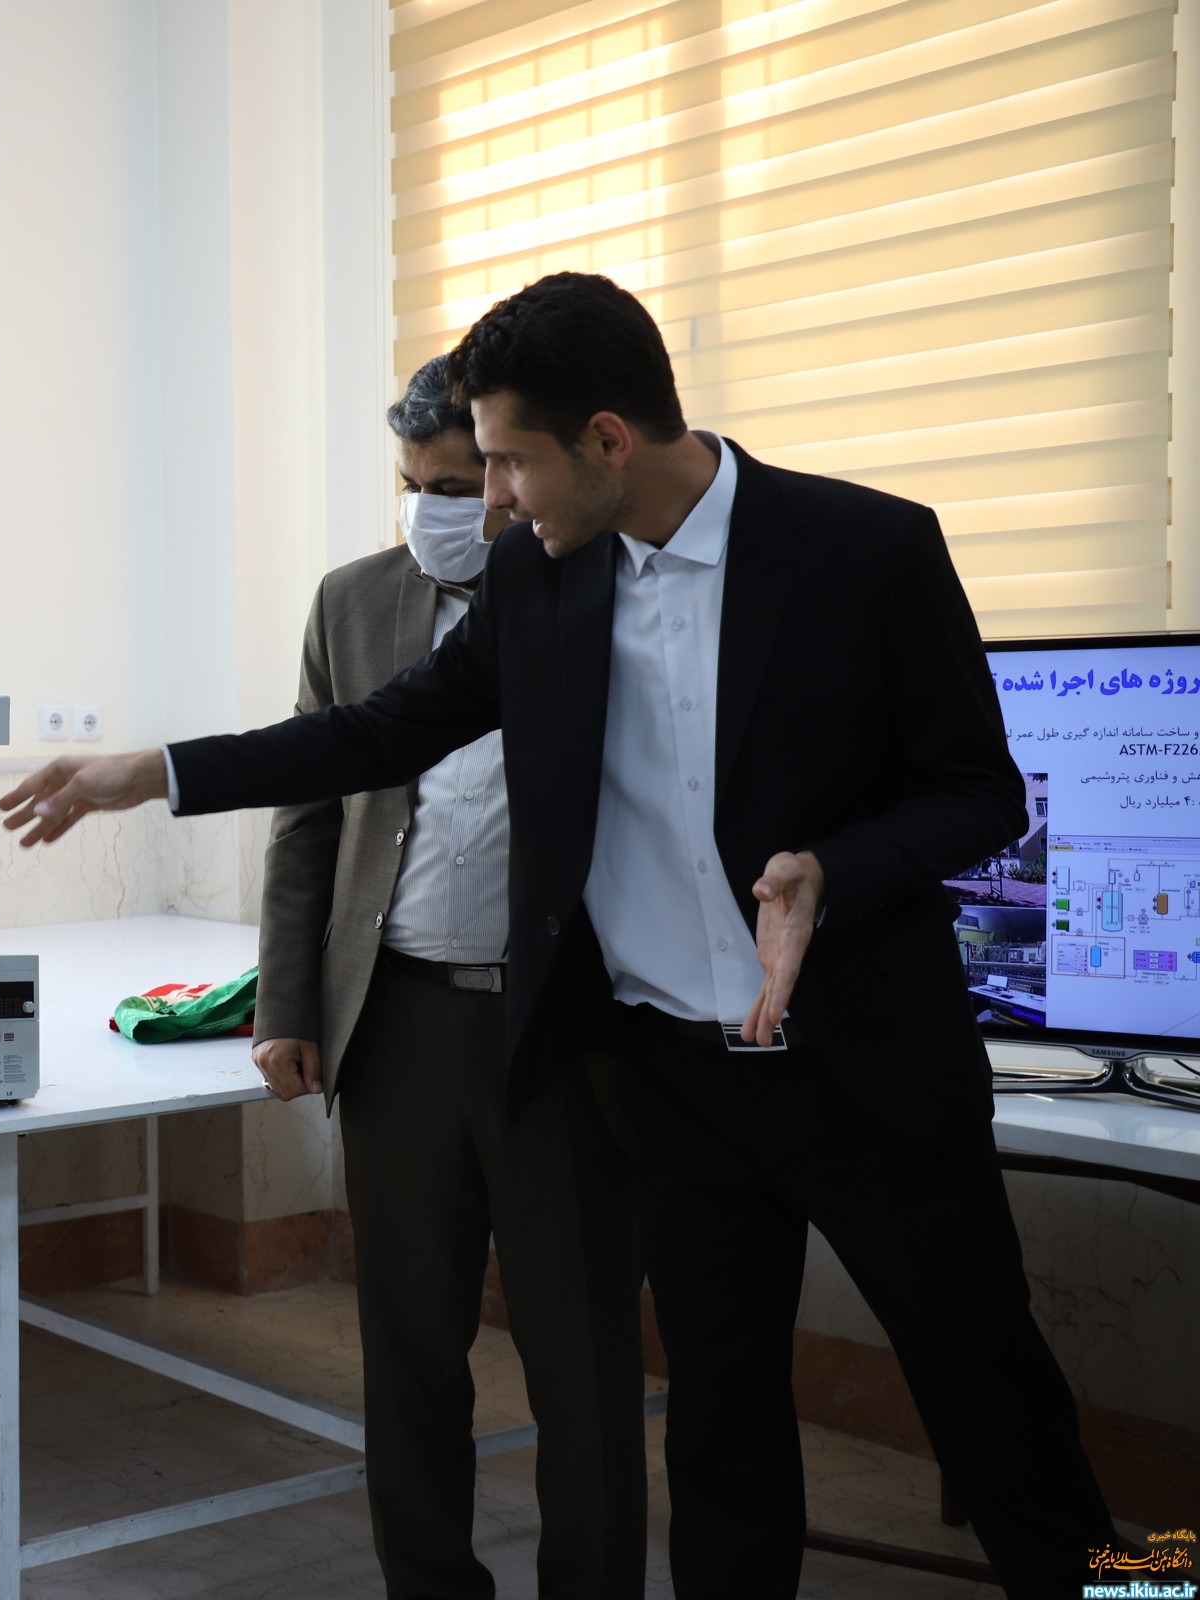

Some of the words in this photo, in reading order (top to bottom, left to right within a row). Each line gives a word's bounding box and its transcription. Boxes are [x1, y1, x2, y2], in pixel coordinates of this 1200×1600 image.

[1002, 671, 1044, 691] شده
[1050, 669, 1094, 697] اجرا
[1100, 668, 1143, 696] های
[1149, 668, 1200, 695] روژه
[1015, 731, 1034, 741] عمر
[1037, 727, 1059, 741] طول
[1062, 726, 1090, 741] گیری
[1093, 726, 1119, 741] اندازه
[1122, 726, 1153, 737] سامانه
[1157, 726, 1190, 737] ساخت
[1119, 743, 1200, 756] ASTM-F226
[1080, 771, 1130, 784] پتروشیمی
[1133, 769, 1169, 784] فناوری
[1119, 795, 1142, 809] ریال
[1145, 795, 1181, 809] میلیارد
[1091, 1049, 1126, 1057] SAMSUNG
